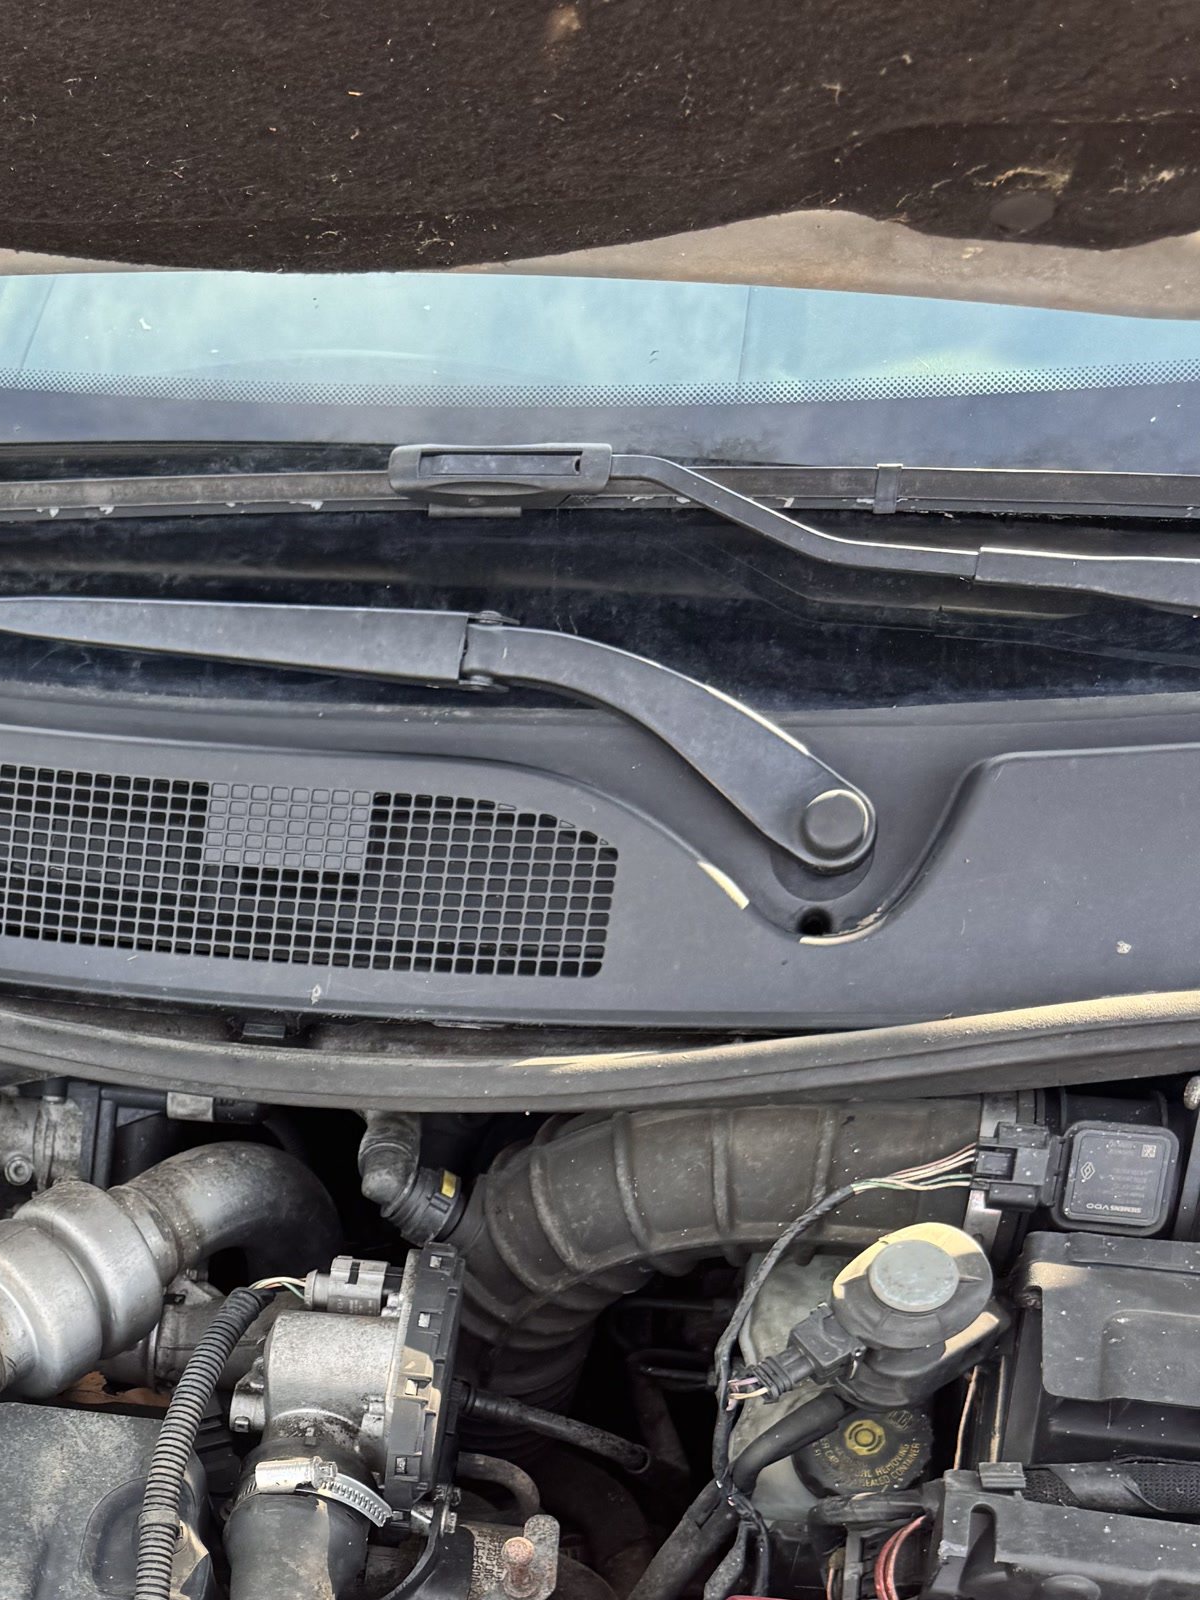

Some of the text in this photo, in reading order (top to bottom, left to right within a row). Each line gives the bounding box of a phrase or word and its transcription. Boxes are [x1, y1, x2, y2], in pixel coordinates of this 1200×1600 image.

[1086, 1202, 1109, 1211] VDO
[875, 1442, 910, 1478] REMOVING
[892, 1442, 921, 1479] CONTAINER
